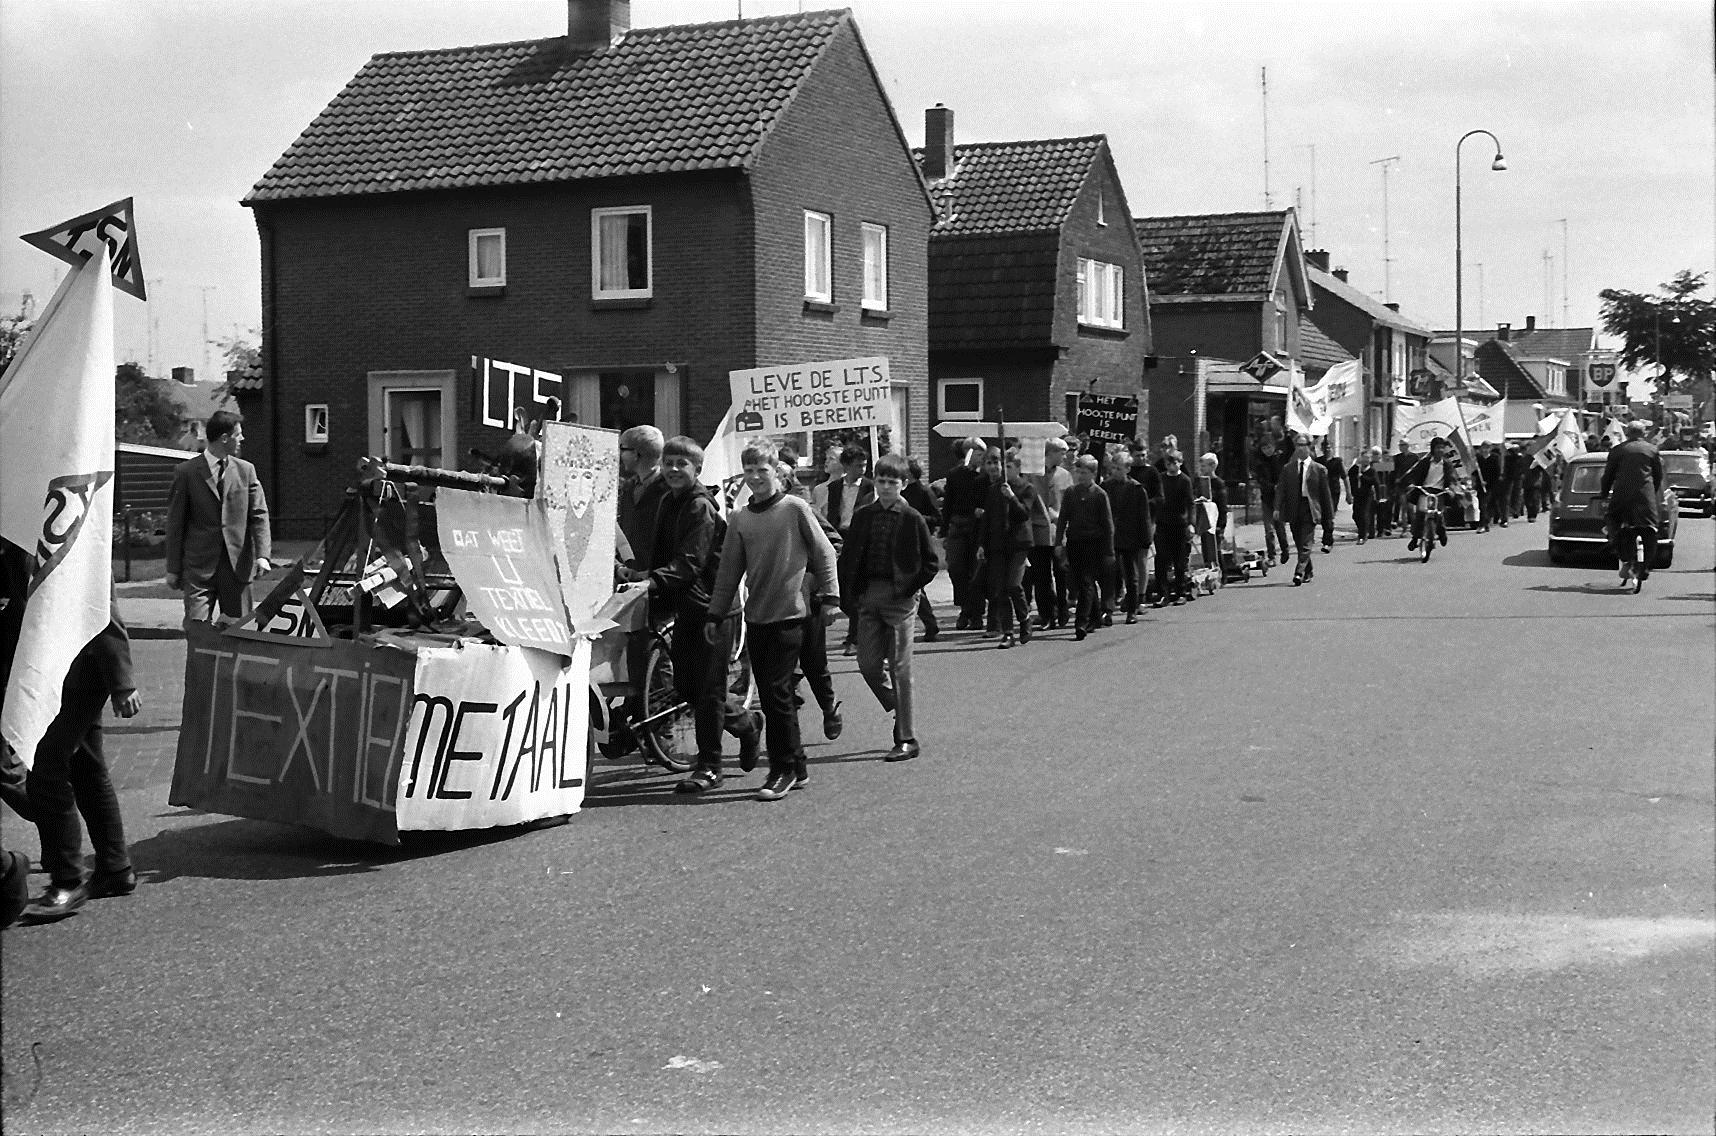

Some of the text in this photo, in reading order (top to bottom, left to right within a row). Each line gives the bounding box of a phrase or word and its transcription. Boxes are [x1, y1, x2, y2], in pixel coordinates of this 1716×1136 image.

[751, 365, 889, 394] LEVE DE L.T.S.
[1593, 367, 1614, 381] BP
[483, 358, 562, 435] LTS
[752, 396, 780, 411] HET
[784, 389, 850, 408] HOOGSTE
[1096, 396, 1117, 405] HET
[775, 405, 877, 429] IS BEREIKT.
[1099, 419, 1110, 428] IS
[452, 528, 525, 553] DAT WEET
[491, 554, 524, 585] U
[480, 587, 554, 611] TEXTIEL
